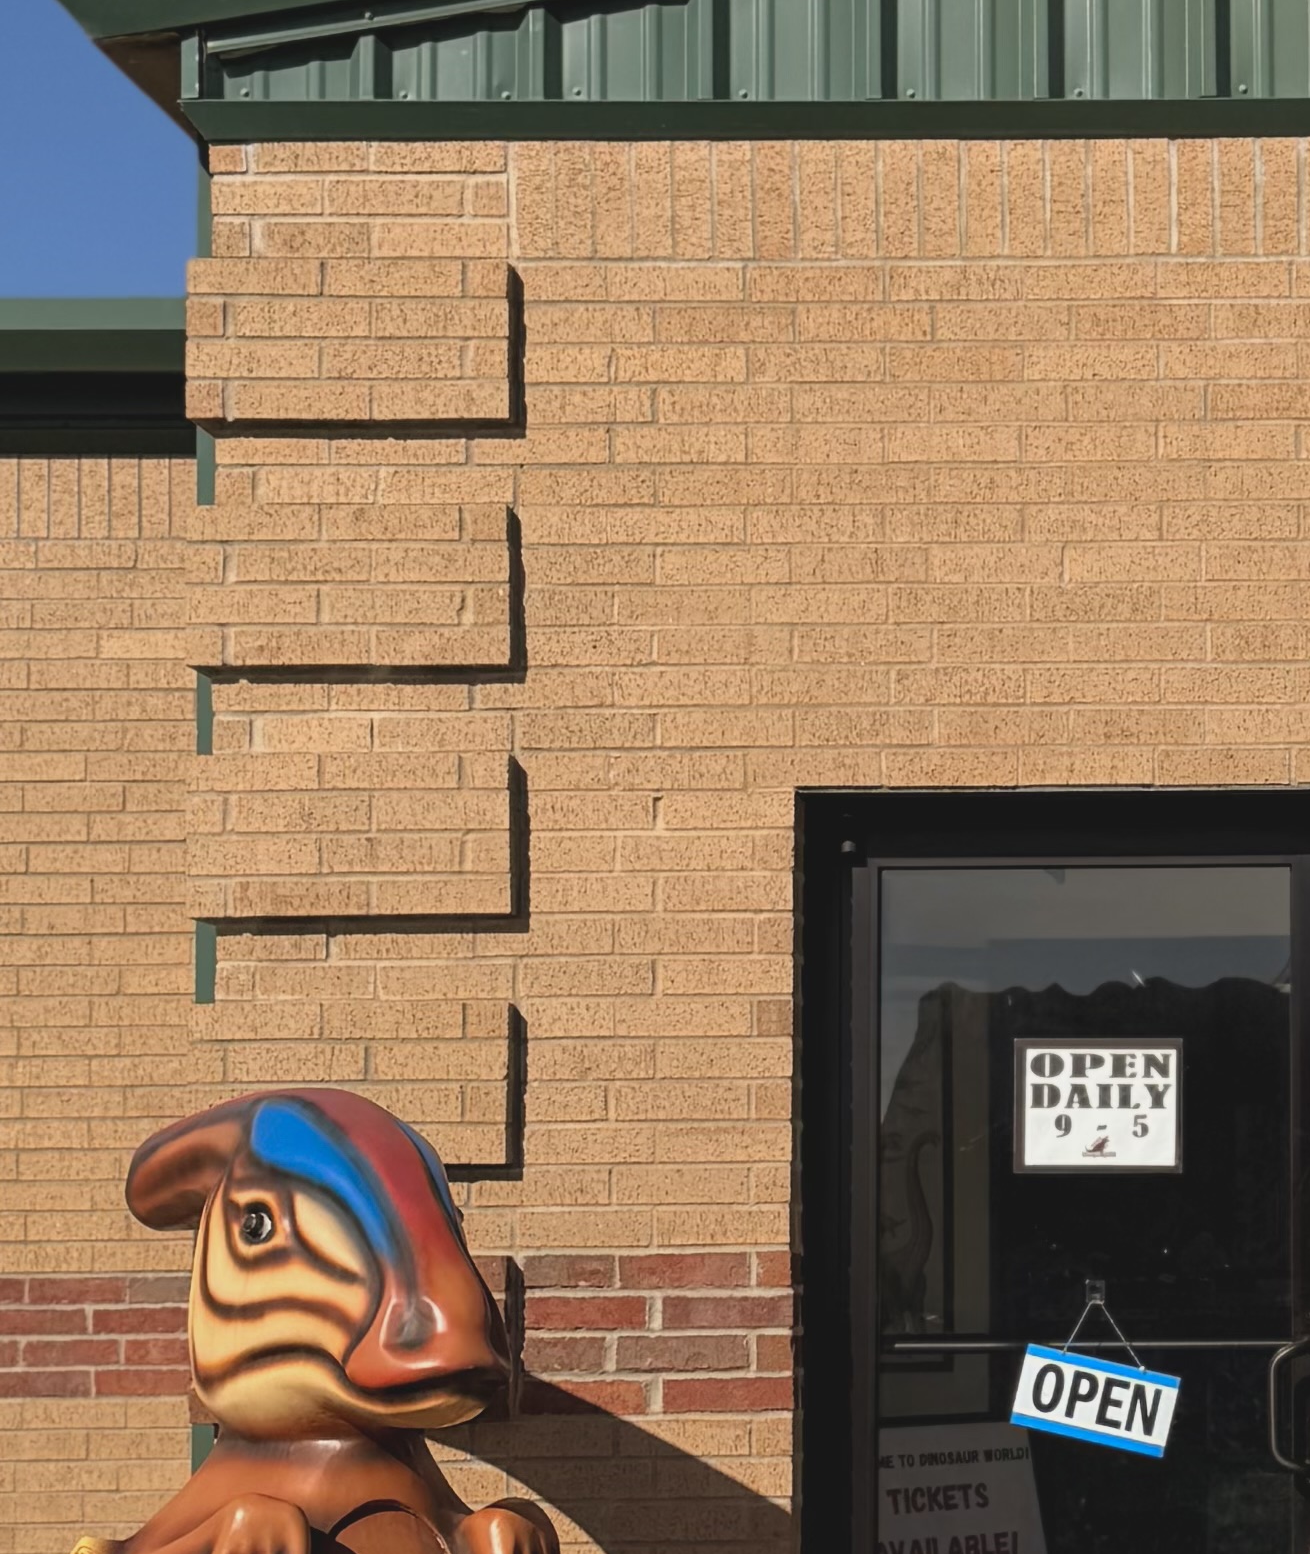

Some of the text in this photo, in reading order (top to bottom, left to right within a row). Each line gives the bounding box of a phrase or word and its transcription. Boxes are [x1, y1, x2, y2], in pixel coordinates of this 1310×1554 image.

[1030, 1052, 1172, 1078] OPEN
[1030, 1083, 1172, 1109] DAILY
[1054, 1114, 1072, 1138] 9
[1132, 1114, 1149, 1138] 5
[1032, 1363, 1162, 1437] OPEN
[898, 1454, 916, 1468] TO
[919, 1450, 979, 1467] DINOSAUR
[984, 1446, 1030, 1463] WORLD!
[886, 1483, 990, 1515] TICKETS
